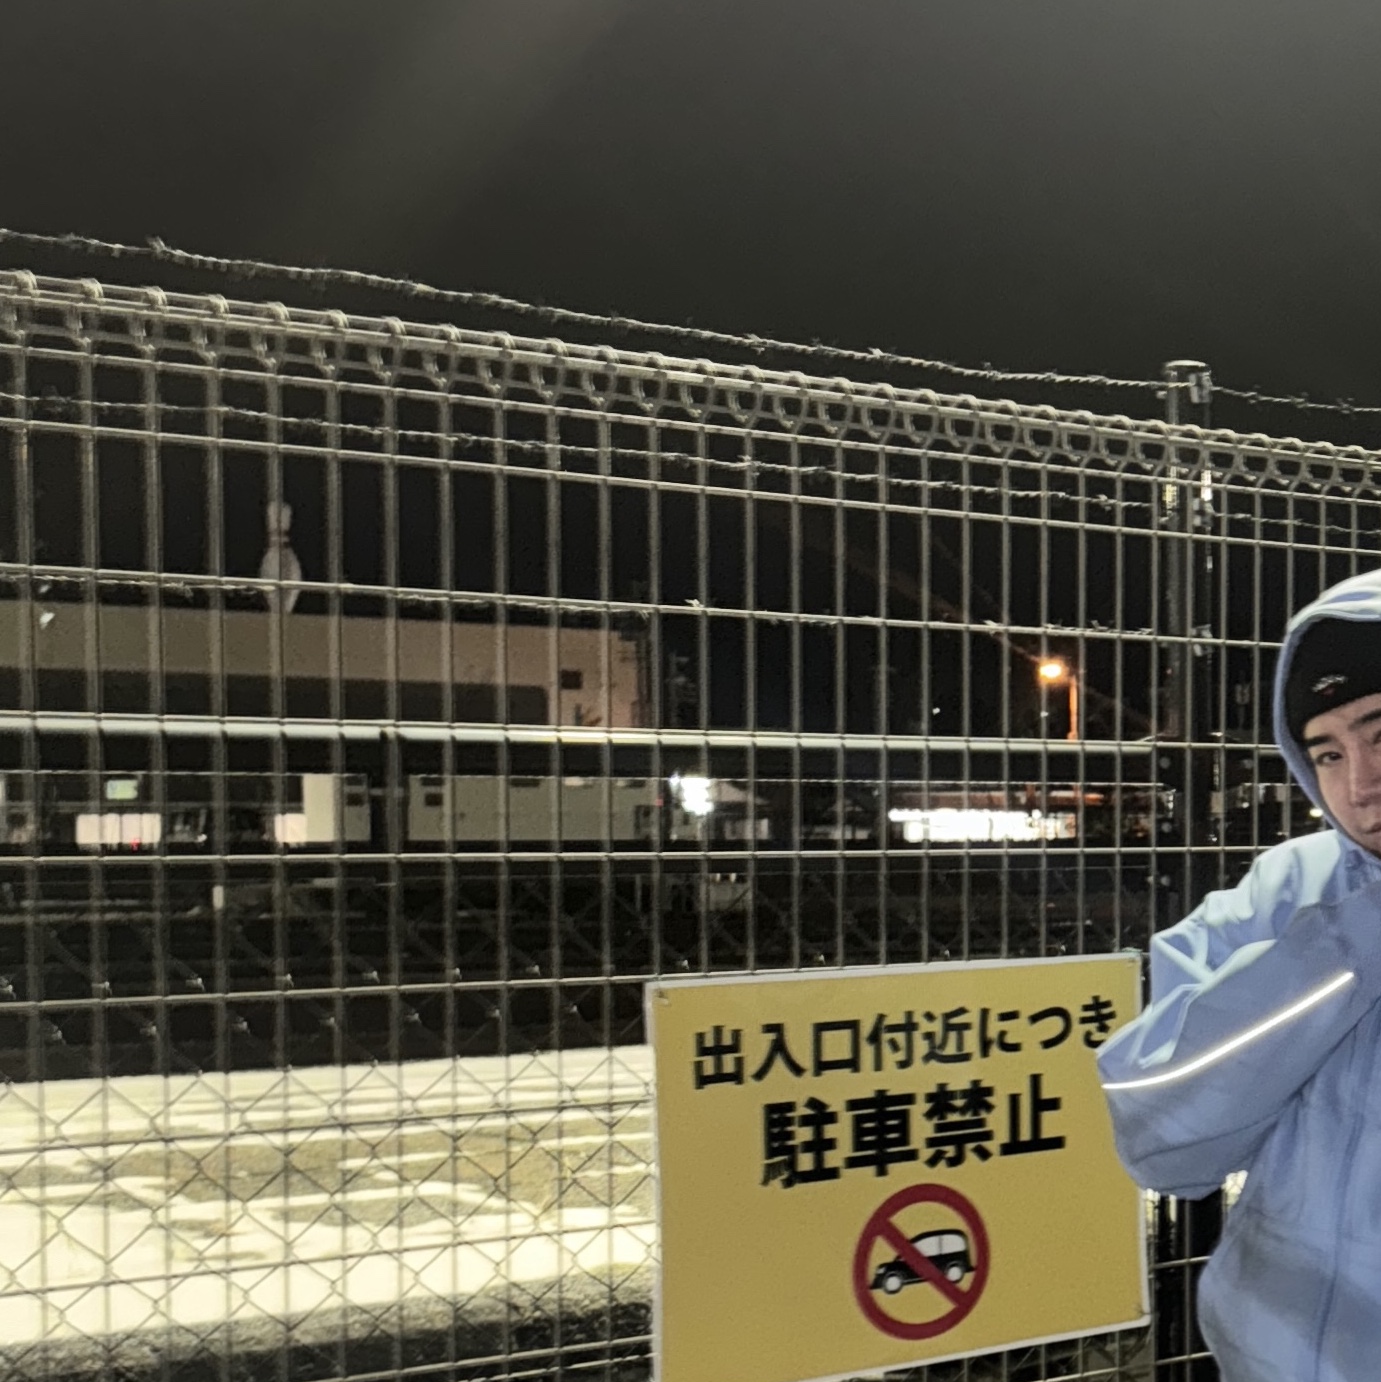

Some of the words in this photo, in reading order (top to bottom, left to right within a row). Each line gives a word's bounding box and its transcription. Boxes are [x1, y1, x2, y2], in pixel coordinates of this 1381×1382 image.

[692, 994, 1117, 1090] 出入口付近につき
[760, 1072, 1066, 1189] 駐車禁止
